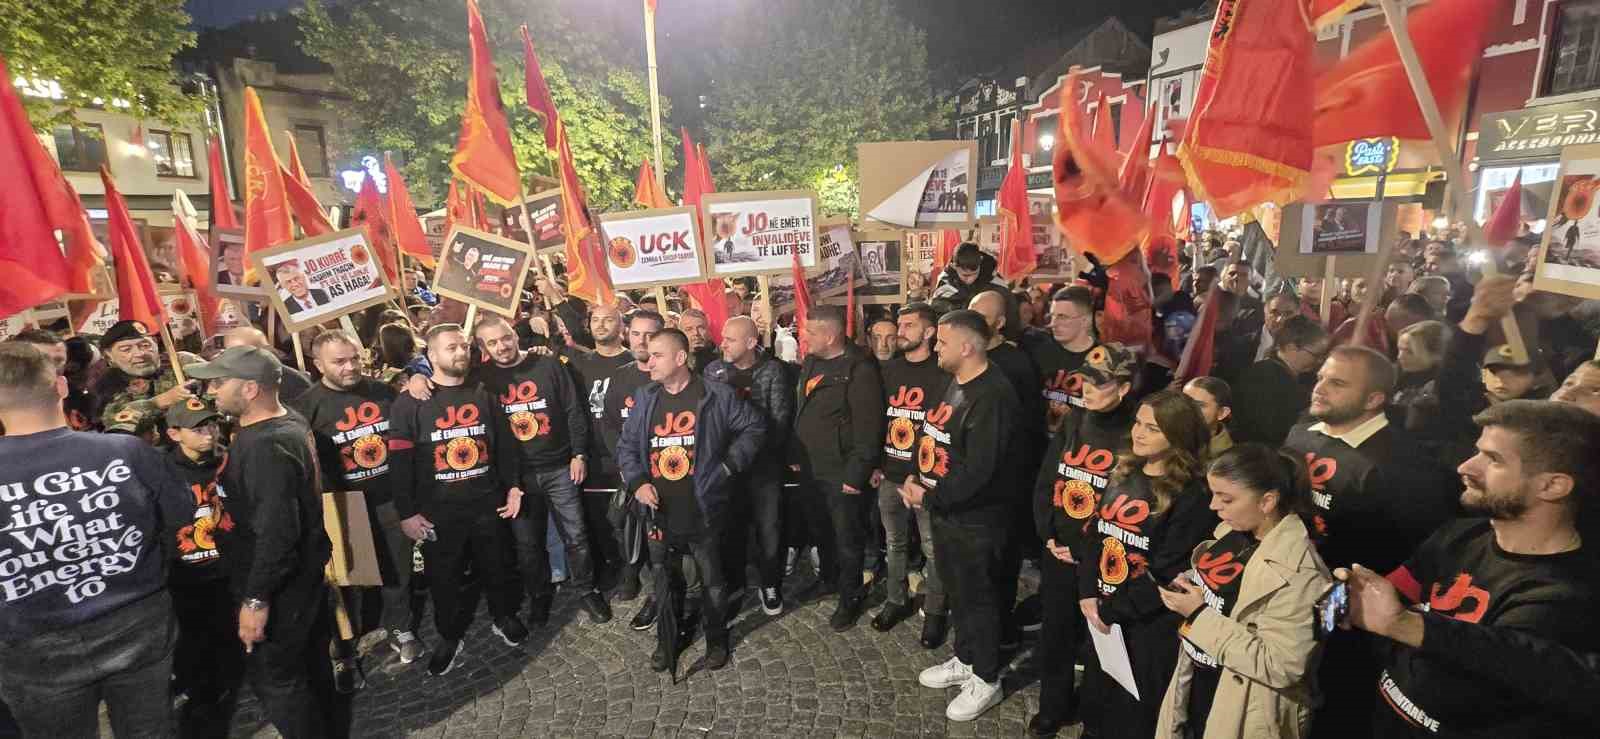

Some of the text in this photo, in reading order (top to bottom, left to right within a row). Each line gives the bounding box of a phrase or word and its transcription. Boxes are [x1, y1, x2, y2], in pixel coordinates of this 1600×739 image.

[742, 211, 811, 235] JO NË EMËR TË
[639, 230, 691, 255] UÇK
[752, 229, 812, 246] INVALIDËVE
[757, 242, 811, 257] TË LUFTËS!
[304, 247, 347, 275] JO KURRË
[328, 283, 345, 299] AS
[343, 274, 371, 293] HAGA!
[500, 380, 541, 405] JO
[889, 385, 925, 408] JO
[335, 401, 382, 431] JO
[435, 403, 480, 429] JO
[654, 410, 697, 436] JO
[926, 401, 954, 429] JO
[1064, 444, 1115, 471] JO
[33, 458, 132, 496] Give
[78, 485, 120, 513] to
[1101, 494, 1150, 524] JO
[9, 511, 125, 551] What
[53, 525, 143, 562] Give
[0, 545, 143, 602] Energy
[1198, 551, 1244, 585] JO
[64, 575, 106, 604] to
[1430, 573, 1491, 624] JO
